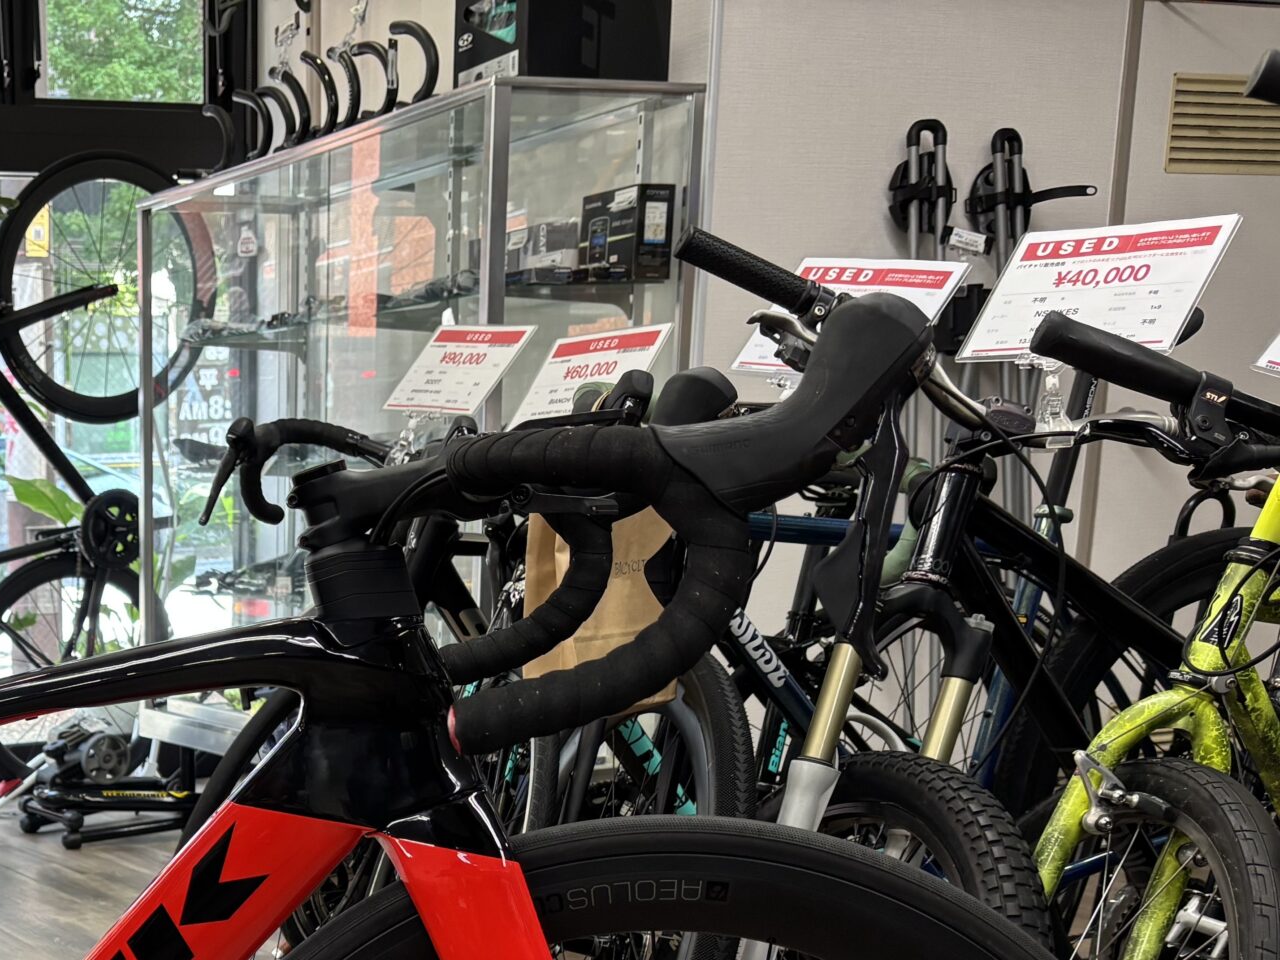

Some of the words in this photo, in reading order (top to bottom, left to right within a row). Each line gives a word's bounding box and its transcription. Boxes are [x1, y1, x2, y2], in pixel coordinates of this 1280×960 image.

[1036, 237, 1120, 257] USED
[808, 267, 874, 283] USED
[1053, 263, 1151, 289] ¥40,000
[1033, 307, 1080, 318] NSIKES
[466, 332, 492, 341] USED
[589, 338, 619, 350] USED
[440, 351, 488, 367] ¥90,000
[563, 360, 618, 381] ¥60,000
